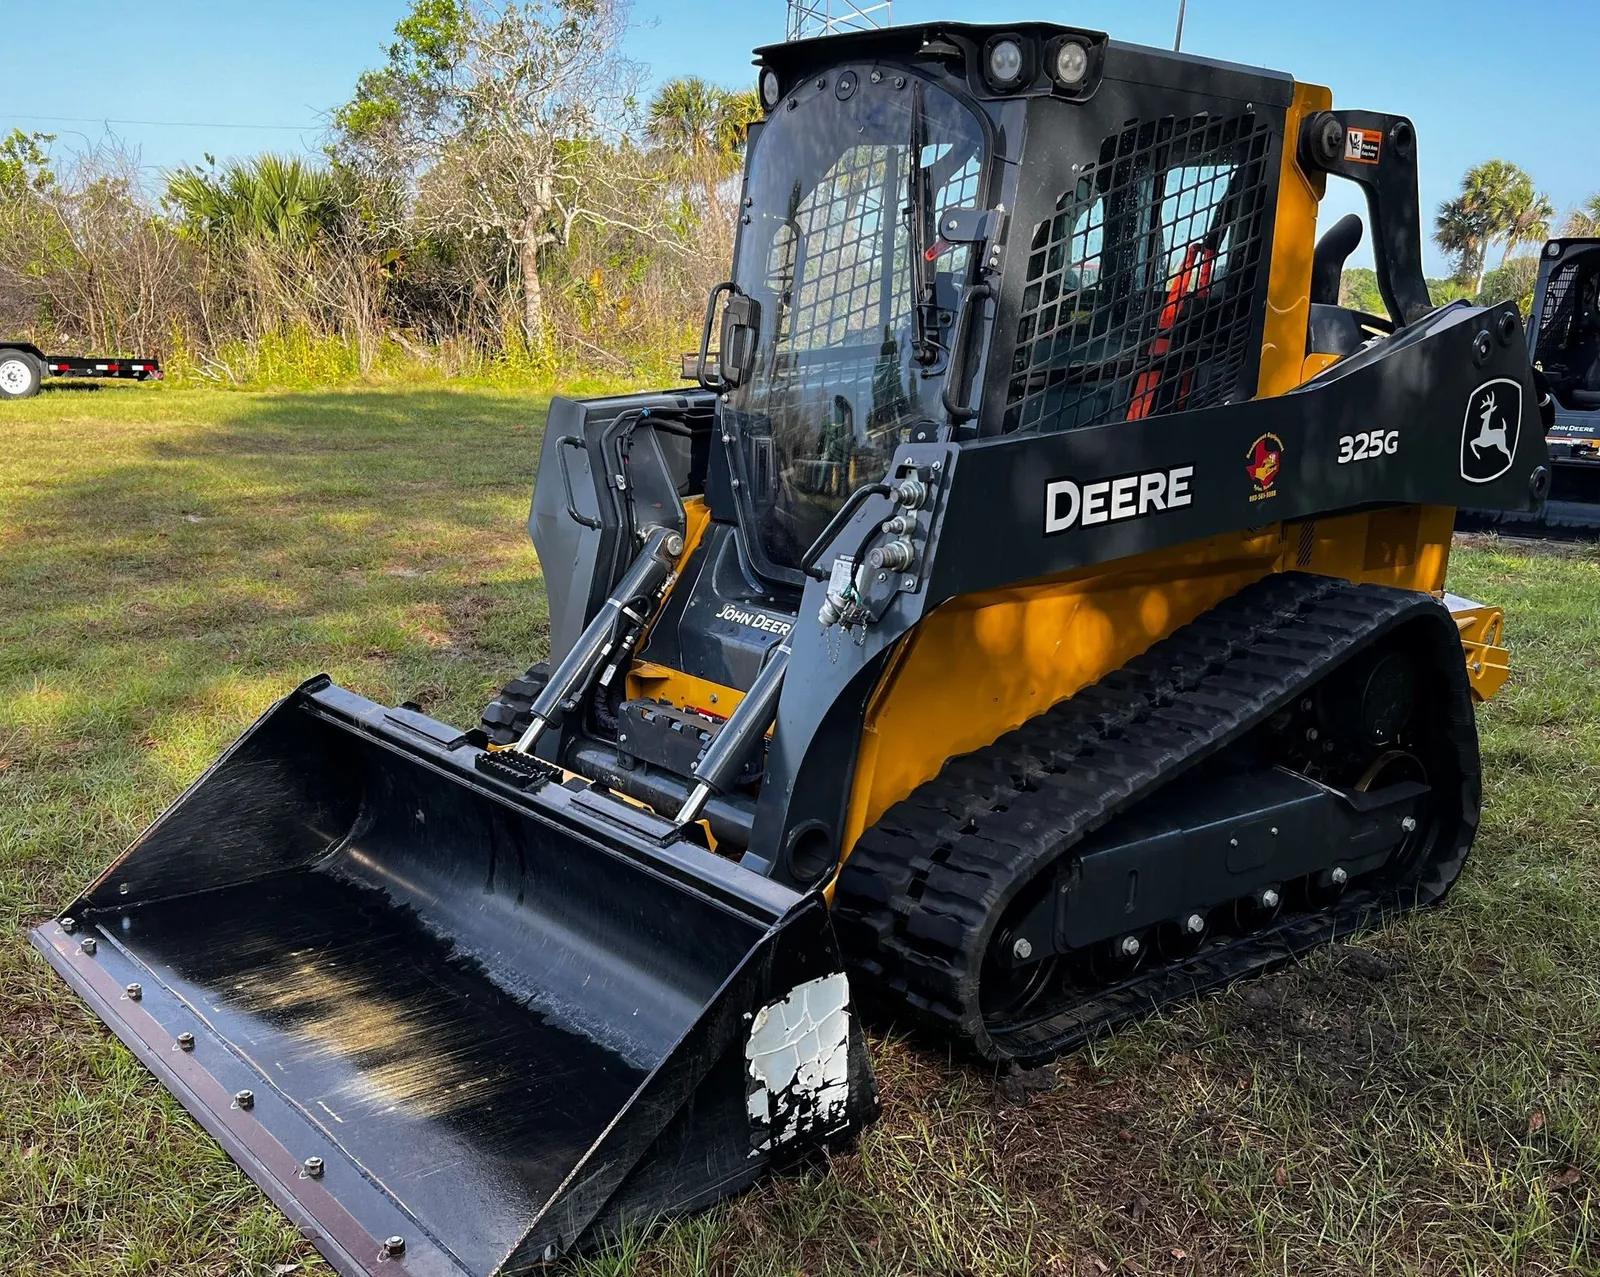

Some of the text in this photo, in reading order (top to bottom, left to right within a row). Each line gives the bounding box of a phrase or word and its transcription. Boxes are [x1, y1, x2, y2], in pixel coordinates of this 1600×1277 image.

[1337, 429, 1400, 464] 325G
[1045, 465, 1194, 534] DEERE
[715, 604, 792, 636] JOHN DEER
